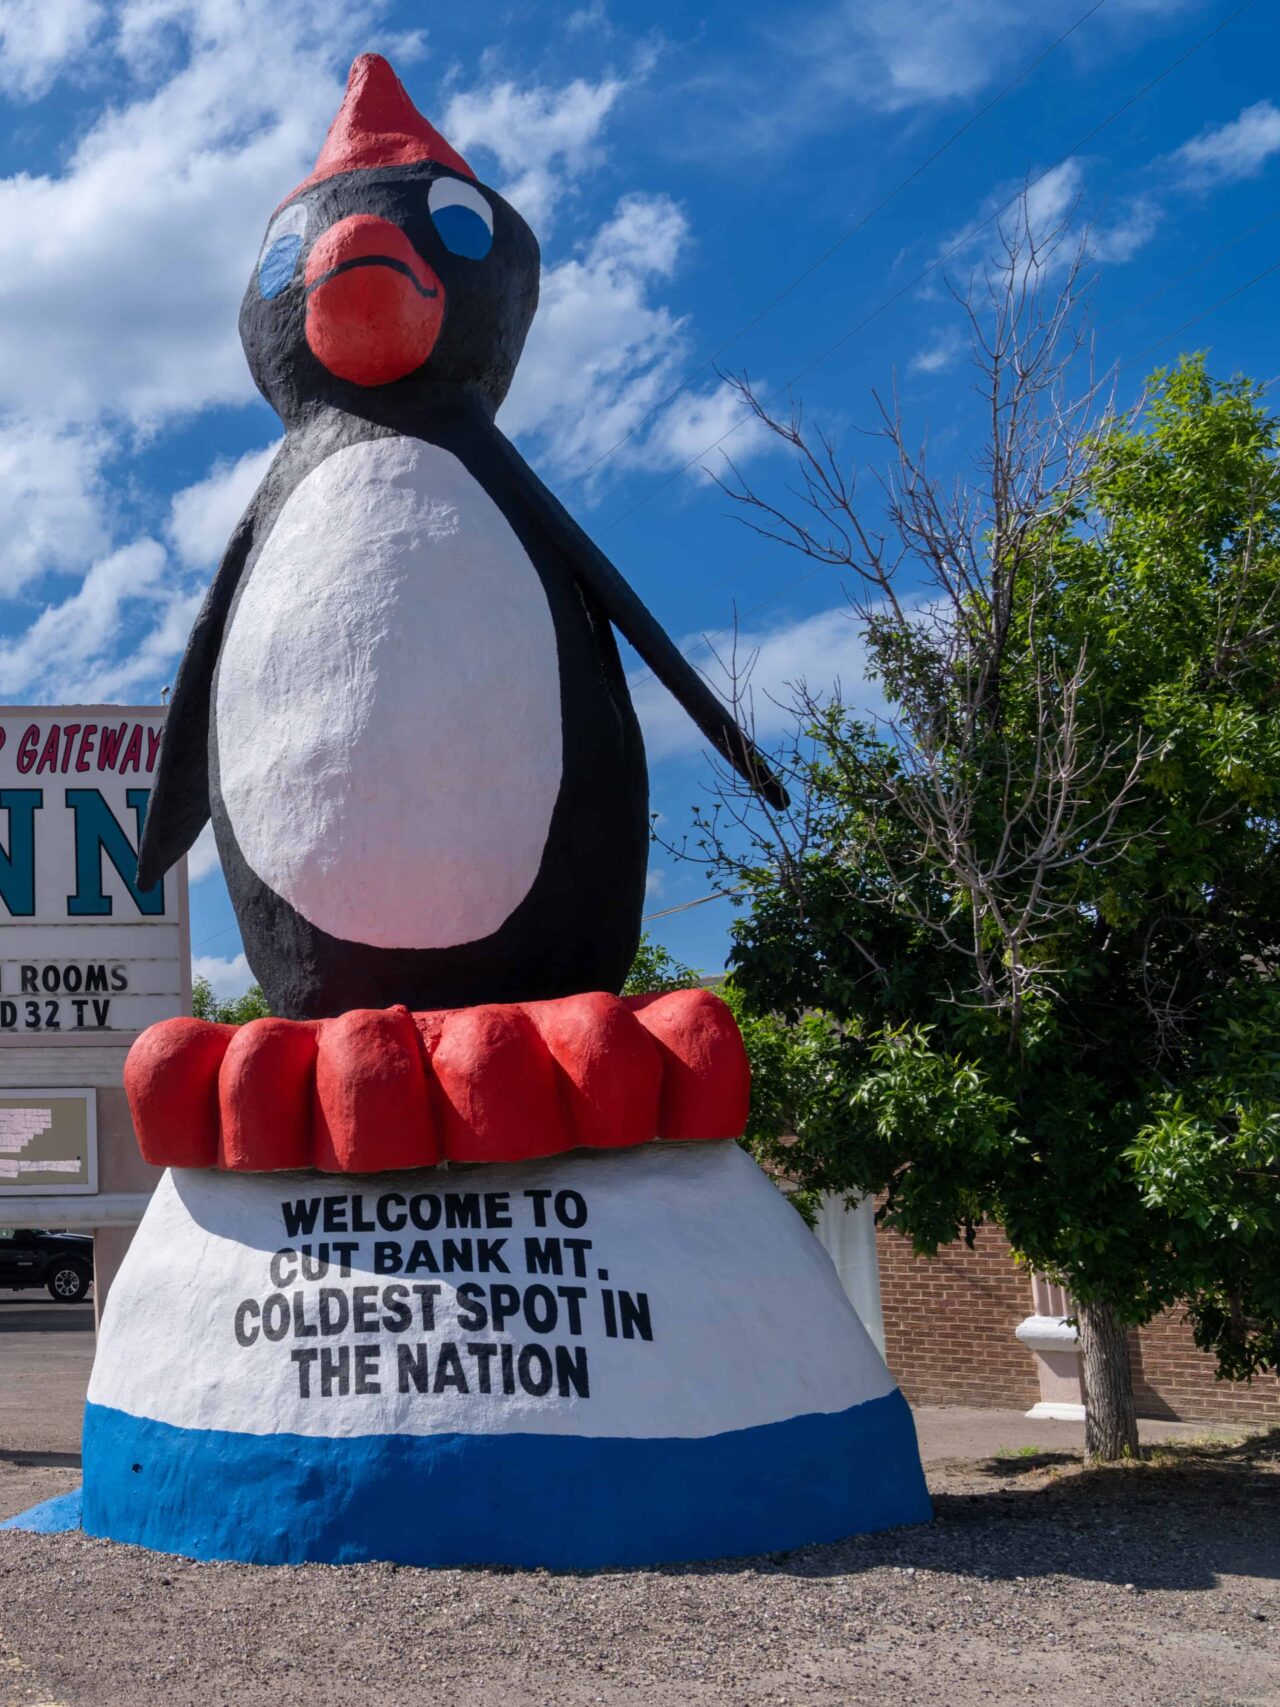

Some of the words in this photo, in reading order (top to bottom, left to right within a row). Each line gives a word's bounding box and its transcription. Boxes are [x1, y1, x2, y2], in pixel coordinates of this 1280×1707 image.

[16, 722, 162, 775] GATEWAY
[20, 964, 129, 994] ROOMS
[71, 999, 111, 1027] TV
[281, 1191, 512, 1238] WELCOME
[523, 1189, 588, 1229] TO
[269, 1241, 359, 1289] CUT
[373, 1238, 511, 1275] BANK
[524, 1237, 609, 1281] MT.
[234, 1284, 441, 1348] COLDEST
[455, 1282, 587, 1336] SPOT
[601, 1288, 654, 1341] IN
[290, 1344, 381, 1399] THE
[397, 1342, 590, 1399] NATION
